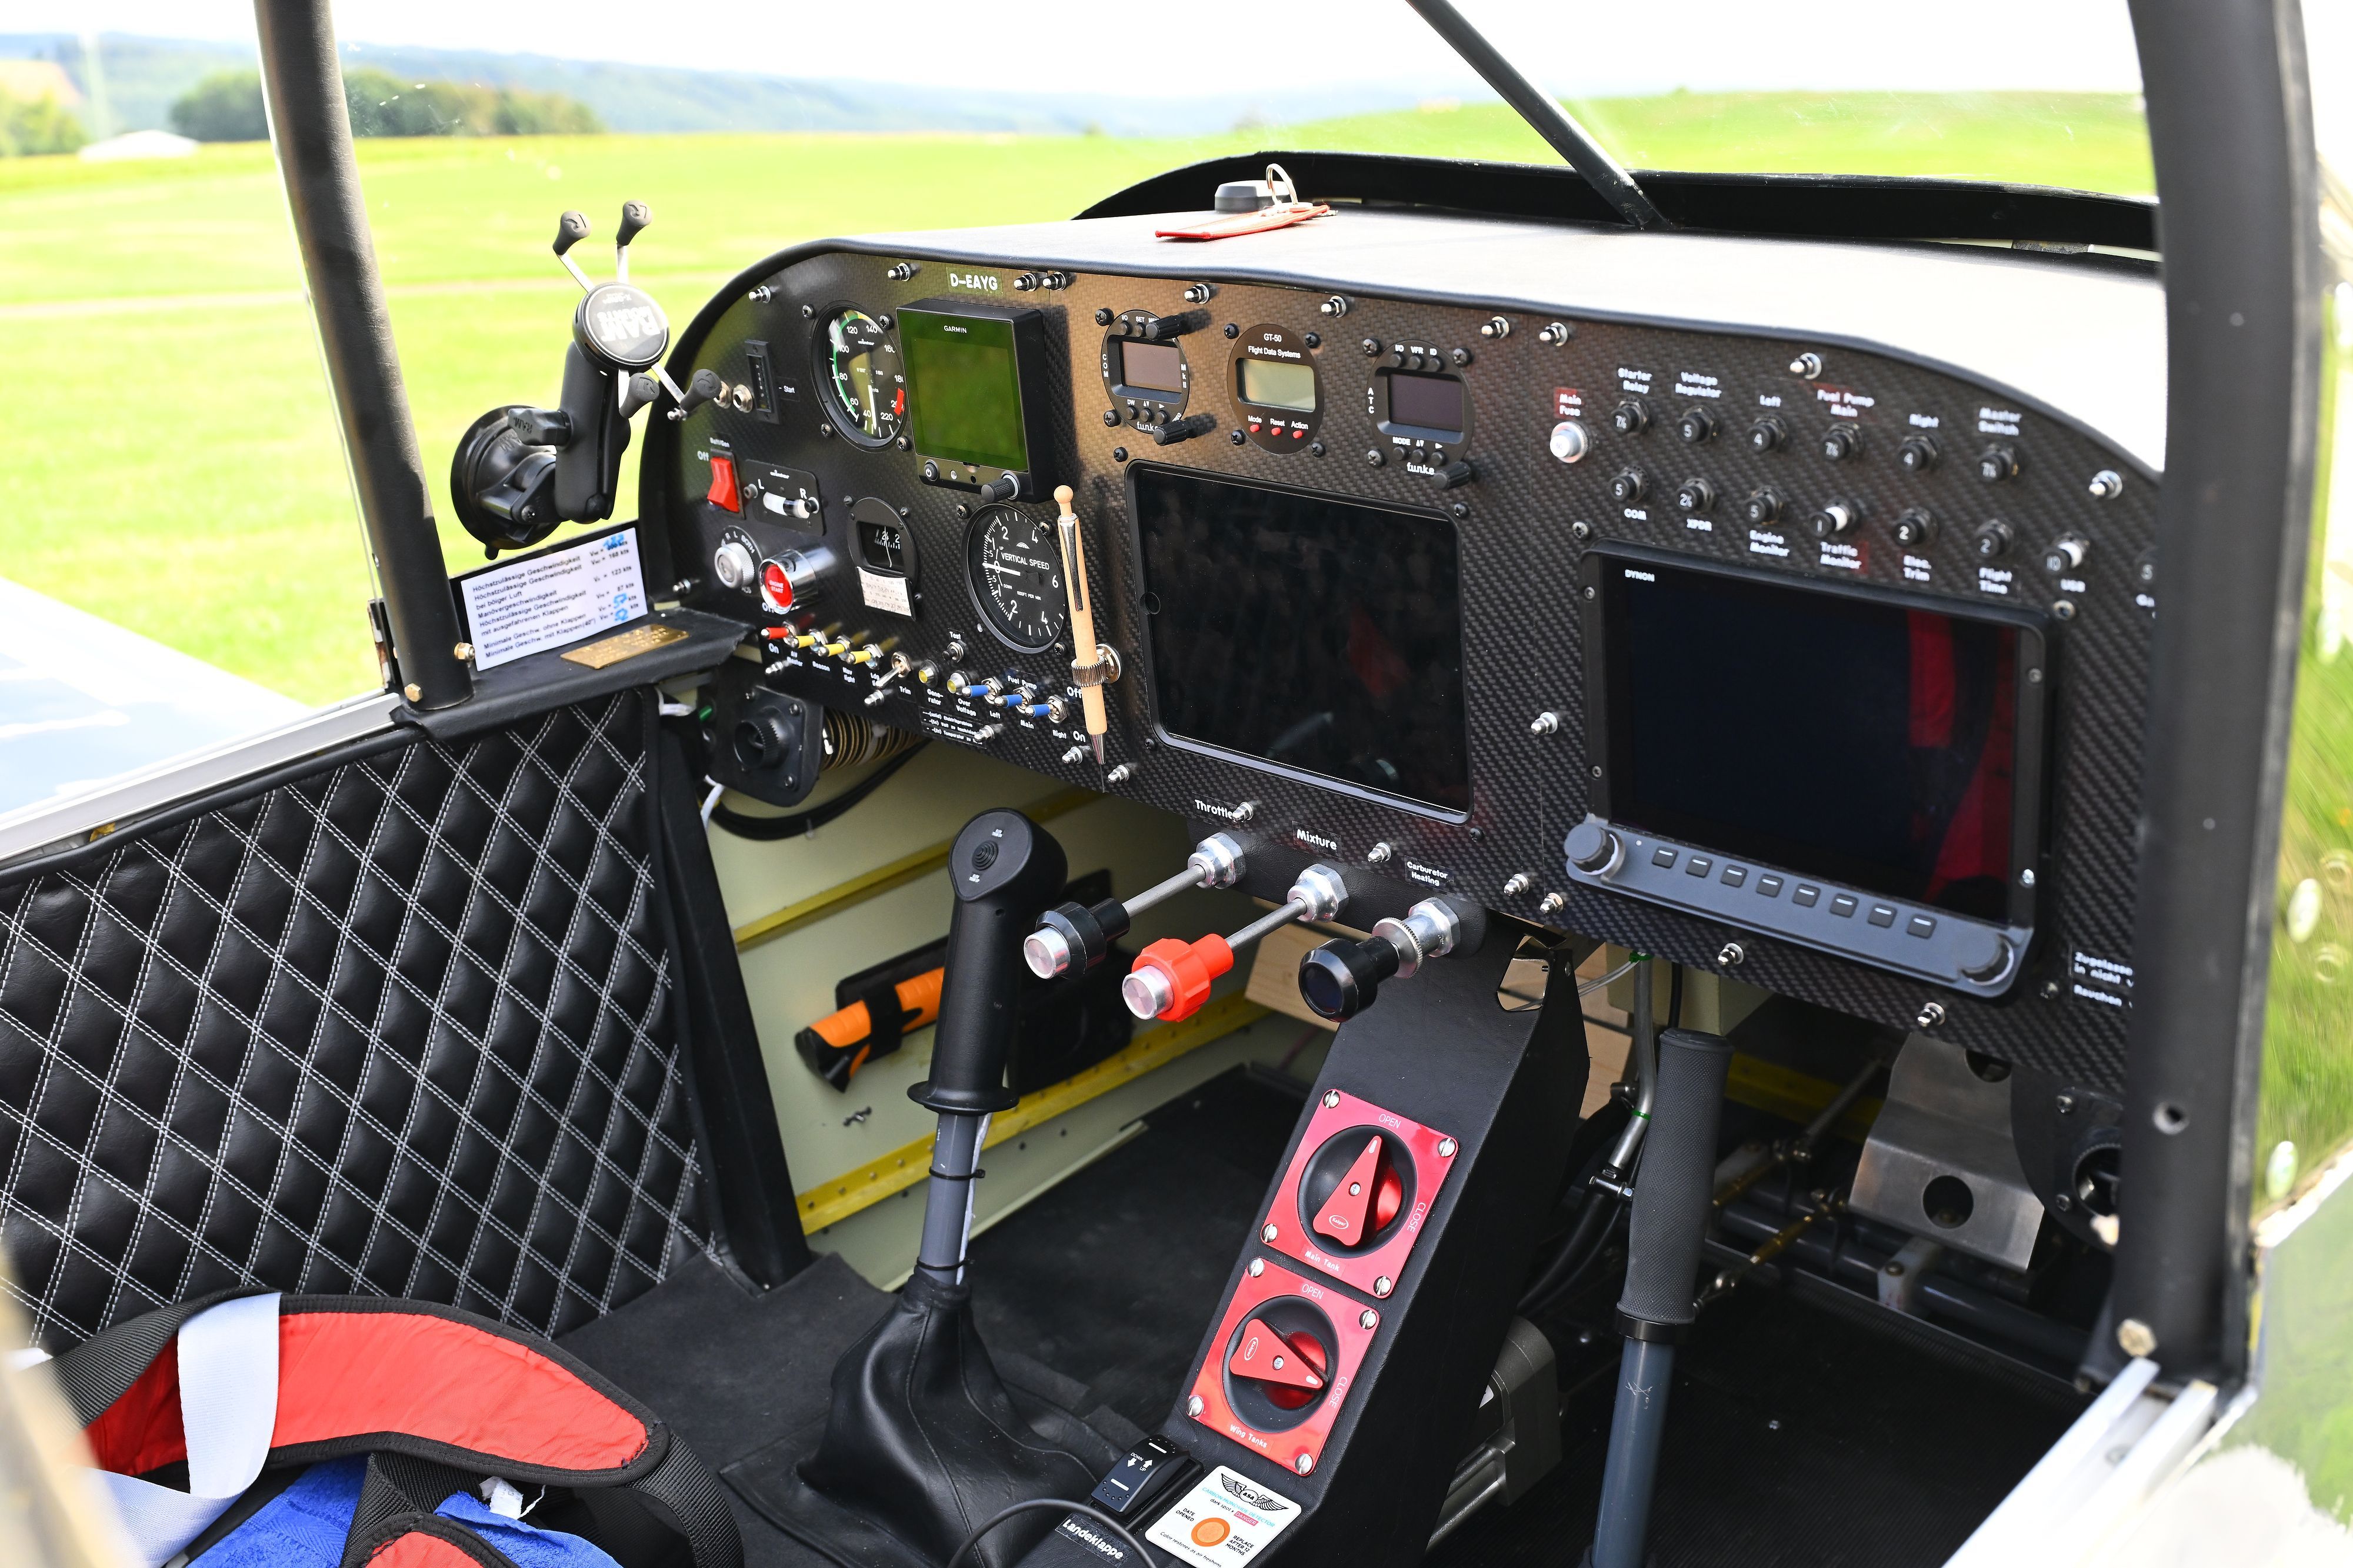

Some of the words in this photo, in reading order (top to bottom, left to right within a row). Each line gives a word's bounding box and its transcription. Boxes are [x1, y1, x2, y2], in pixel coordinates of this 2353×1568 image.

[950, 273, 998, 291] D-EAYG
[601, 314, 661, 342] RAM
[846, 325, 858, 335] 120
[866, 325, 878, 333] 140
[943, 325, 968, 334] GARMIN
[1264, 333, 1282, 343] GT-50
[839, 345, 849, 353] 100
[1248, 345, 1264, 355] Flight
[1264, 347, 1277, 356] Data
[1277, 349, 1301, 359] Systems
[1411, 346, 1424, 354] VFR
[839, 372, 848, 381] 80
[1618, 367, 1652, 382] Starter
[784, 385, 795, 394] Start
[850, 398, 859, 406] 60
[1559, 393, 1582, 405] Main
[1759, 395, 1782, 408] Left
[863, 409, 872, 418] 40
[880, 412, 894, 421] 220
[1559, 405, 1581, 416] Fuse
[1248, 415, 1262, 423] Mode
[1270, 418, 1285, 427] Reset
[1291, 421, 1309, 430] Action
[1684, 424, 1692, 438] 5
[1392, 436, 1411, 446] MODE
[697, 451, 709, 461] Off
[770, 469, 789, 479] winter
[758, 478, 765, 490] L
[1615, 483, 1623, 496] 5
[800, 488, 806, 499] R
[1624, 508, 1647, 521] COM
[1750, 504, 1759, 518] 5
[1001, 526, 1009, 541] 2
[1031, 529, 1039, 544] 4
[1899, 525, 1909, 541] 2
[1820, 541, 1858, 558] Traffic
[1980, 538, 1991, 554] 2
[1001, 552, 1028, 566] VERTICAL
[1029, 558, 1050, 571] SPEED
[1819, 554, 1862, 570] Monitor
[473, 572, 525, 592] Höchstzulässige
[527, 555, 581, 576] Geschwindigkeit
[1625, 569, 1655, 582] DYNON
[1904, 566, 1931, 582] Trim
[1979, 566, 2012, 582] Flight
[475, 581, 527, 601] Höchstzulässige
[529, 565, 582, 584] Geschwindigkeit
[1052, 575, 1059, 588] 6
[478, 590, 558, 619] Manövergeschwindigkeit
[488, 596, 508, 608] böiger
[509, 591, 523, 599] Luft
[480, 607, 532, 628] Höchstzulässige
[534, 590, 586, 610] Geschwindigkeit
[542, 605, 569, 616] Klappen
[1010, 599, 1018, 614] 2
[1041, 610, 1048, 625] 4
[484, 636, 512, 649] Minimale
[543, 622, 559, 630] ohne
[561, 613, 586, 625] Klappen
[949, 630, 962, 640] Test
[485, 645, 514, 658] Minimale
[768, 642, 779, 654] On
[1007, 675, 1019, 685] Fuel
[1021, 679, 1038, 691] Pump
[899, 685, 911, 695] Trim
[926, 688, 944, 698] Gene-
[1066, 686, 1082, 699] Off
[928, 697, 942, 706] rator
[958, 697, 971, 707] Over
[956, 705, 976, 717] Voltage
[989, 710, 1001, 719] Left
[1020, 719, 1034, 730] Main
[1052, 729, 1067, 740] Right
[1072, 730, 1086, 742] On
[1194, 799, 1236, 820] Throttle
[1297, 828, 1337, 850] Mixture
[1407, 861, 1448, 880] Carburetor
[1411, 871, 1440, 887] Heating
[1378, 1113, 1401, 1129] OPEN
[1407, 1202, 1427, 1233] CLOSE
[1304, 1250, 1321, 1264] Main
[1323, 1258, 1341, 1272] Tank
[1301, 1283, 1324, 1300] OPEN
[1328, 1376, 1348, 1409] CLOSE
[1229, 1424, 1246, 1439] Wing
[1248, 1433, 1268, 1449] Tanks
[1130, 1452, 1144, 1463] DOWN
[1242, 1491, 1255, 1501] asa
[1202, 1486, 1224, 1500] CARBON
[1223, 1496, 1249, 1514] MONOXIDE
[1248, 1507, 1276, 1528] DETECTOR
[1209, 1497, 1221, 1506] dark
[1220, 1503, 1231, 1513] spot
[1176, 1510, 1195, 1522] OPENED
[1182, 1507, 1196, 1517] DATE
[1235, 1512, 1258, 1526] DANGER
[1062, 1518, 1124, 1560] Landeklappe
[1160, 1531, 1173, 1540] Color
[1172, 1537, 1192, 1552] restores
[1229, 1539, 1245, 1550] AFTER
[1232, 1535, 1255, 1549] REPLACE
[1225, 1543, 1246, 1557] MONTHS
